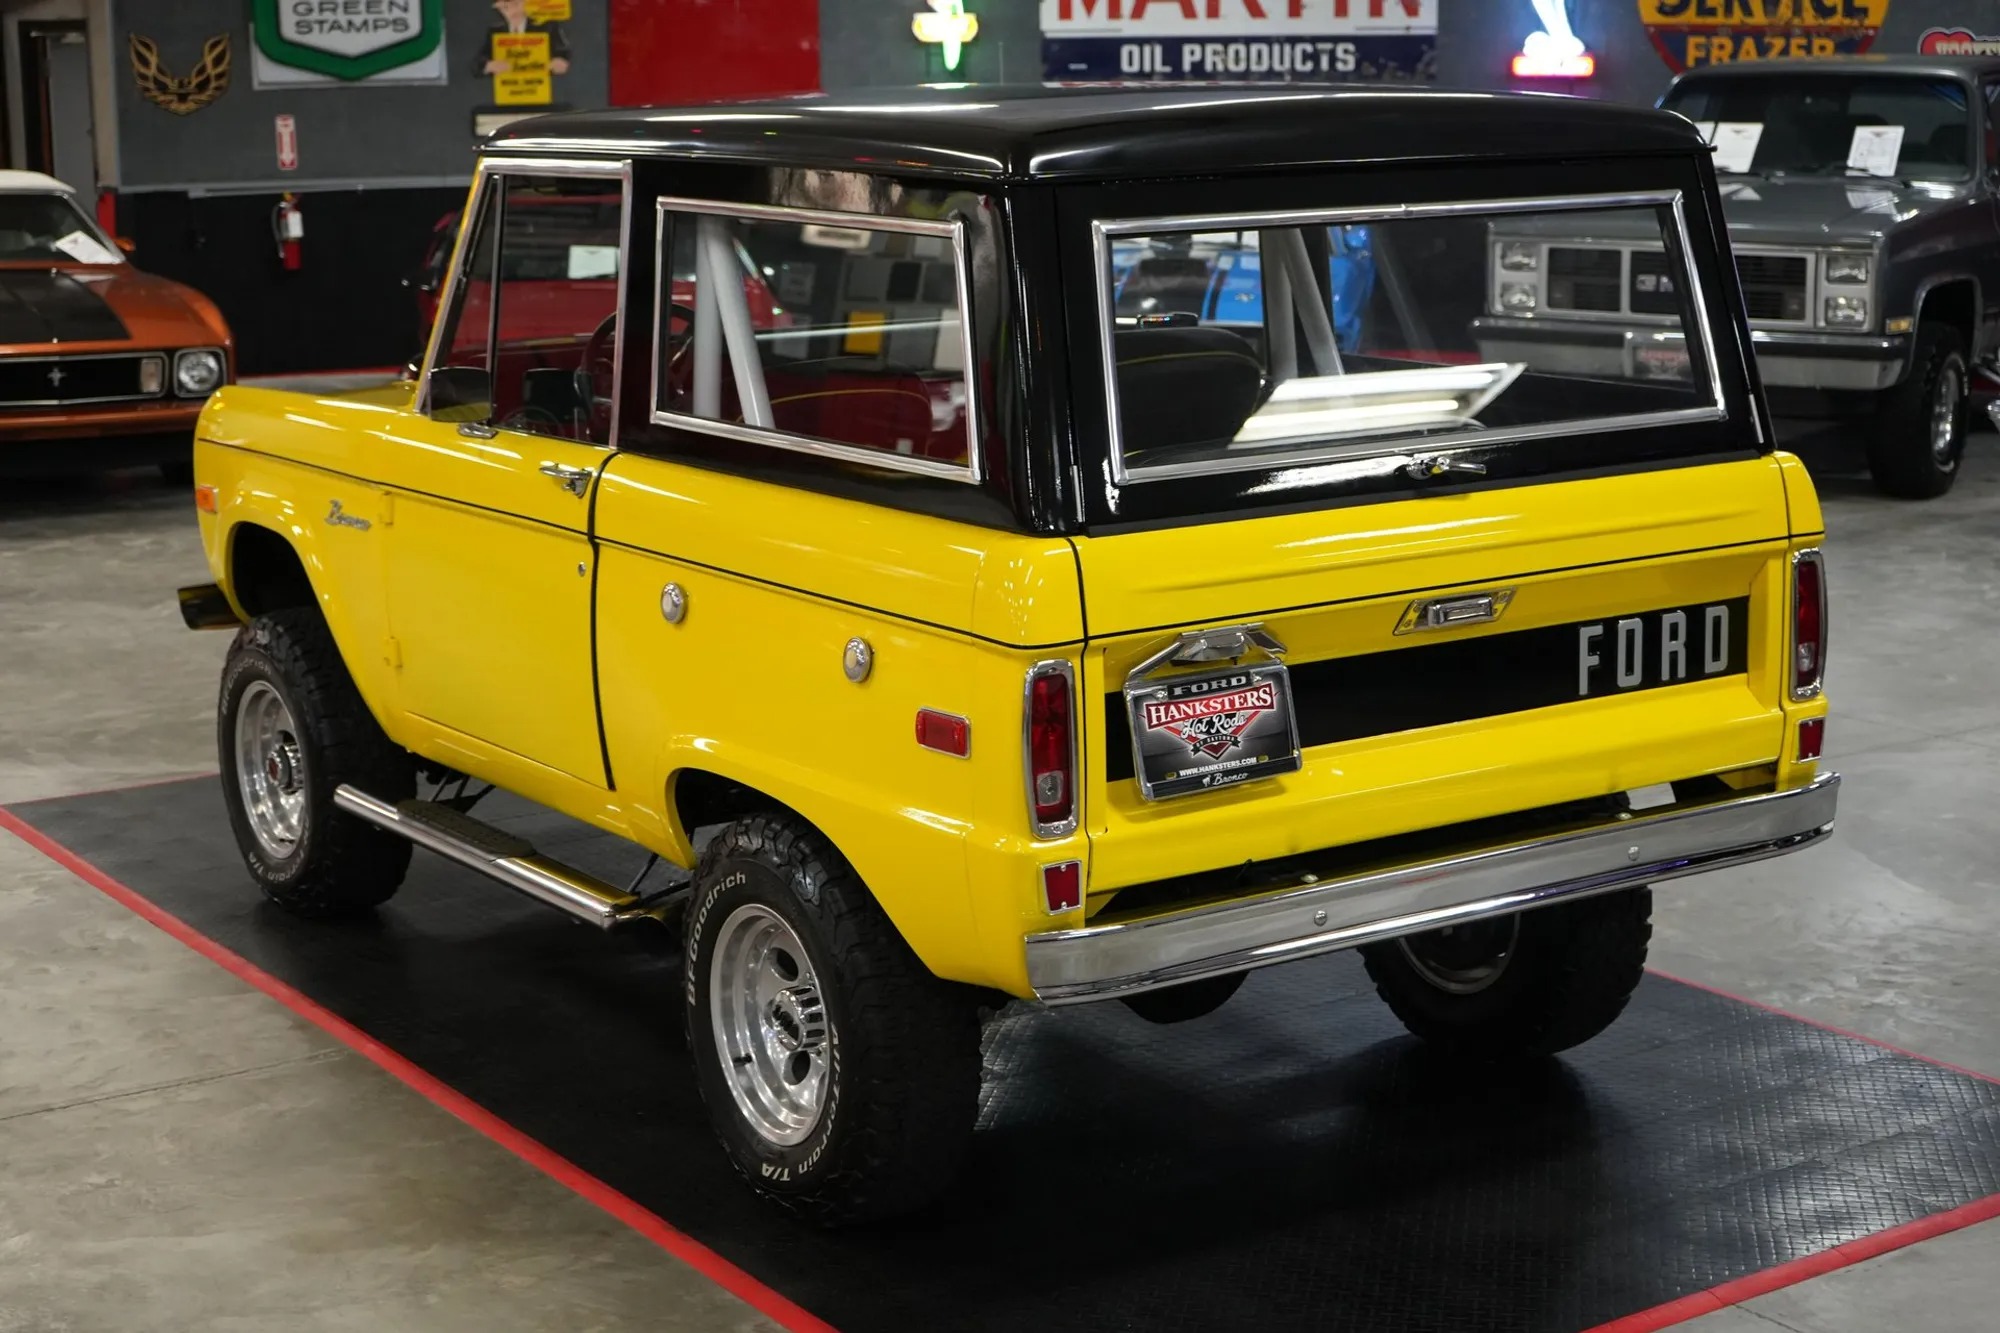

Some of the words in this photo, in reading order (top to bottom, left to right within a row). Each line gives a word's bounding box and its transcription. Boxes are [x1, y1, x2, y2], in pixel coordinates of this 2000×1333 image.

[292, 0, 410, 17] GREEN
[294, 17, 410, 36] STAMPS
[1120, 43, 1172, 74] OIL
[1181, 41, 1357, 74] PRODUCTS
[1578, 604, 1730, 696] FORD
[1172, 675, 1248, 696] FORD
[1149, 686, 1273, 727] HANKSTERS
[1181, 716, 1211, 739] Hot
[1210, 712, 1248, 735] Rods
[1178, 756, 1258, 777] WWW.HANKSTERS.COM
[1212, 772, 1249, 786] Bronco
[761, 1162, 791, 1182] T/A
